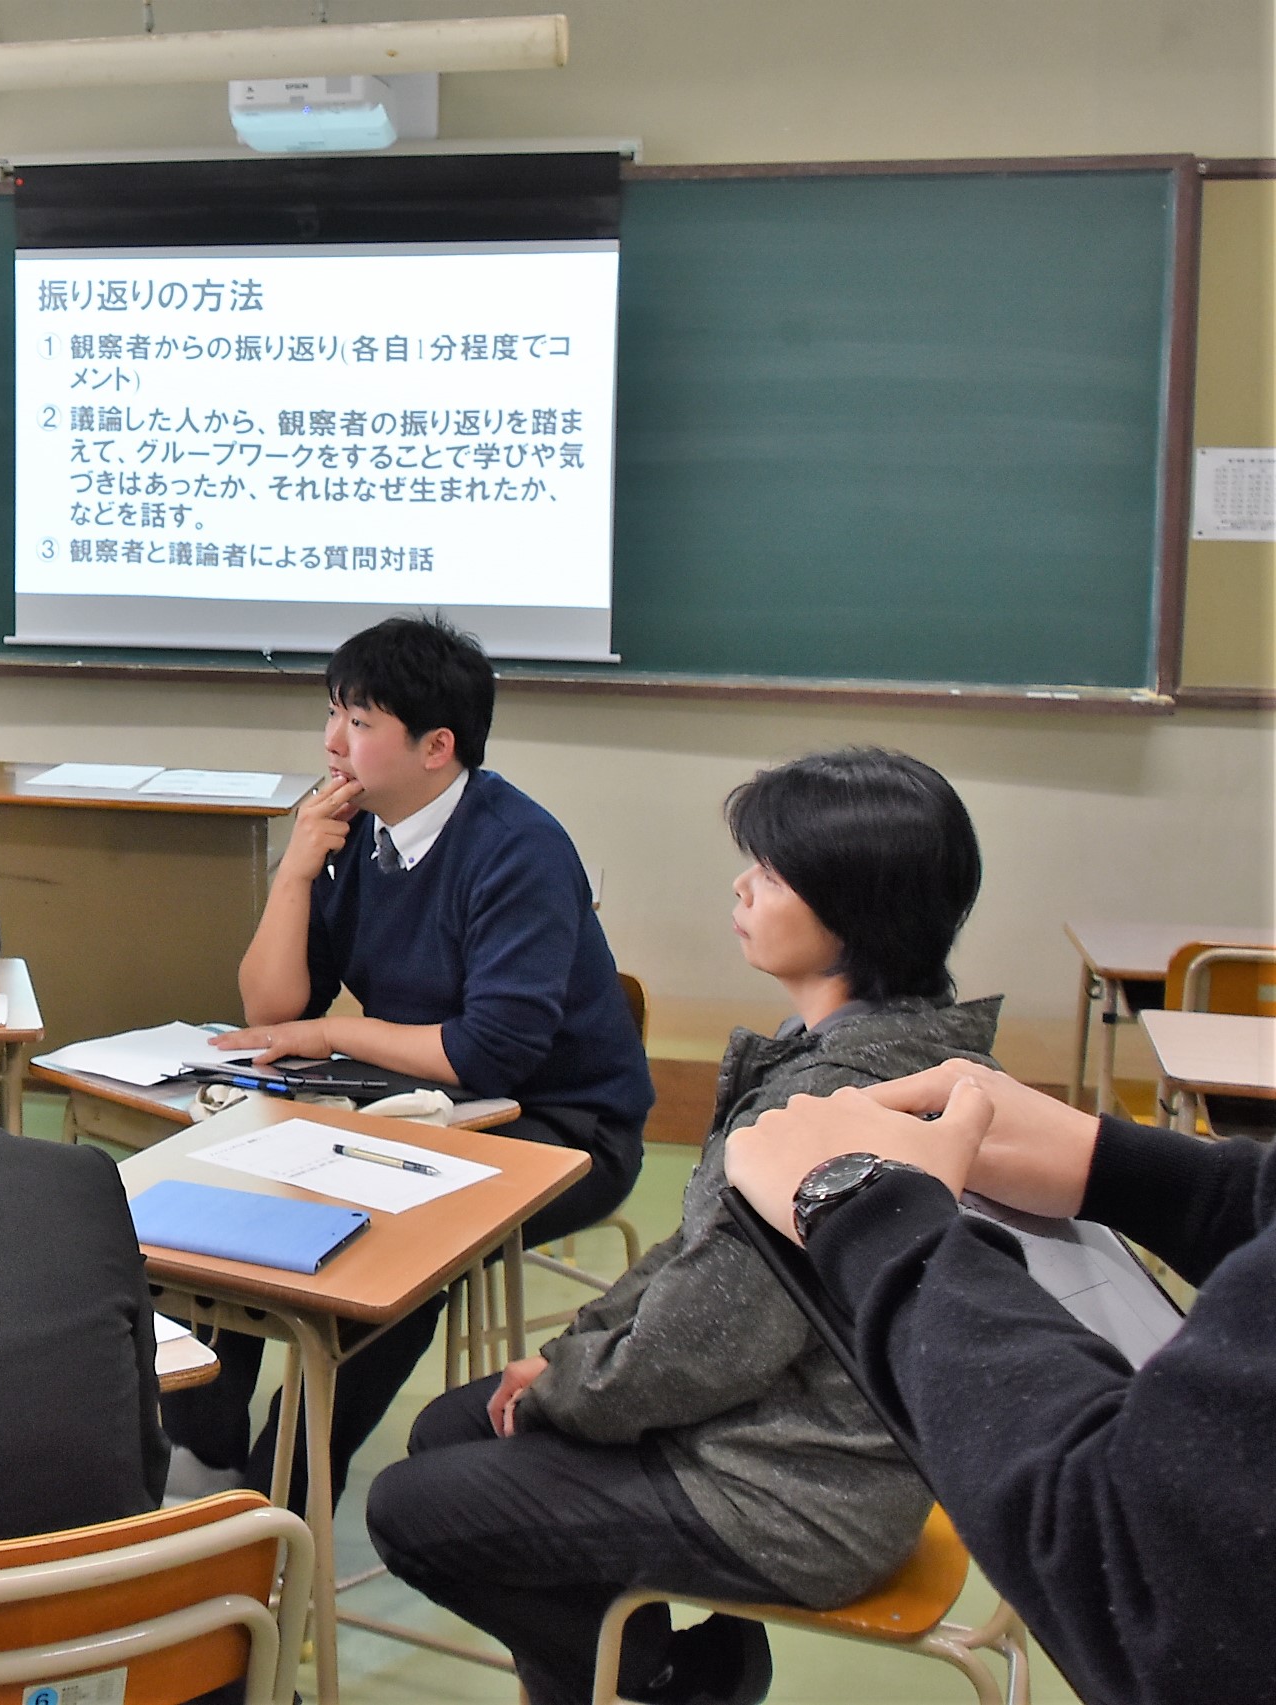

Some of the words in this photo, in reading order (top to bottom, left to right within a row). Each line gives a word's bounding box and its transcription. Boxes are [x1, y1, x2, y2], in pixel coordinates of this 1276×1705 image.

[38, 278, 263, 312] 振り返りの方法
[70, 366, 141, 393] メント)
[70, 405, 582, 437] 議論した人から、観察者の振り返りを踏ま
[70, 438, 584, 469] えて、グループワークをすることで学びや気
[70, 470, 557, 502] づきはあったか、それはなぜ生まれたか、
[70, 501, 203, 530] などを話す。
[70, 538, 434, 572] 観察者と議論者による質問対話
